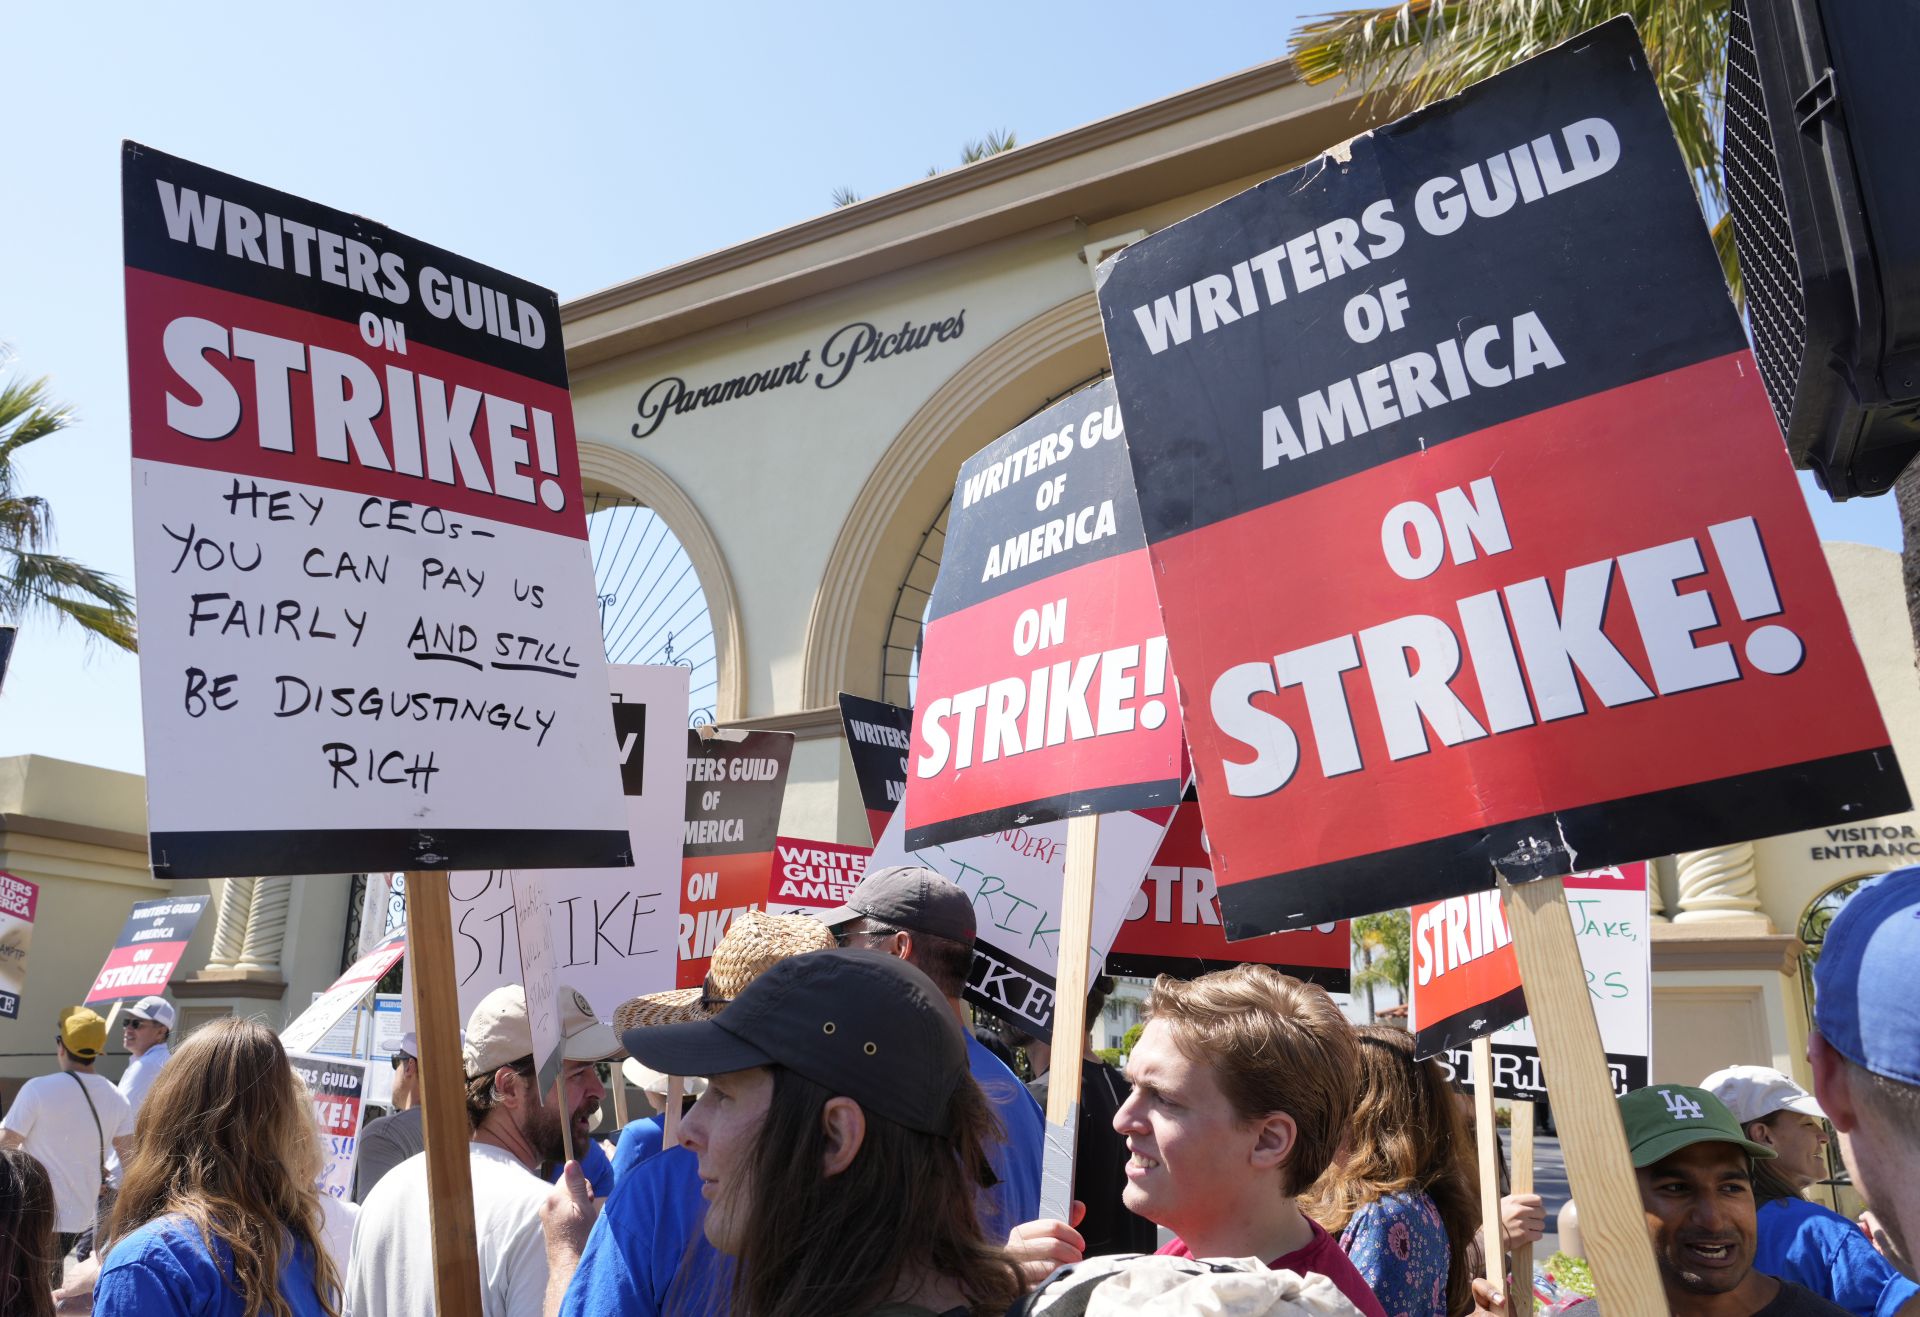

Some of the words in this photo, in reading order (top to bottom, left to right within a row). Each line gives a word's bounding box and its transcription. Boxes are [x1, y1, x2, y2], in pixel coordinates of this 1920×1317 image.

[1133, 198, 1405, 355] WRITERS
[1415, 117, 1621, 236] GUILD
[156, 179, 410, 305] WRITERS
[418, 266, 546, 350] GUILD
[358, 311, 408, 355] ON
[1343, 278, 1410, 344] OF
[631, 349, 810, 439] Paramount
[815, 308, 966, 390] Pictures
[1262, 310, 1567, 470] AMERICA
[162, 316, 566, 513] STRIKE!
[962, 433, 1073, 510] WRITERS
[1036, 474, 1067, 512] OF
[222, 479, 324, 526] HEY
[981, 499, 1117, 583] AMERICA
[1380, 475, 1513, 580] ON
[162, 523, 262, 574] YOU
[302, 547, 390, 586] CAN
[421, 557, 485, 595] PAY
[513, 578, 545, 608] US
[188, 593, 367, 647] FAIRLY
[407, 617, 478, 655] AND
[494, 632, 582, 670] STILL
[1013, 597, 1068, 657] ON
[1209, 516, 1806, 798] STRIKE!
[183, 666, 239, 718] BE
[273, 675, 556, 747] DISGUSTINGLY
[917, 635, 1169, 780] STRIKE!
[849, 719, 911, 751] WRITERS
[321, 742, 440, 794] RICH
[686, 758, 727, 782] TERS
[729, 758, 779, 782] GUILD
[702, 790, 721, 811] OF
[683, 818, 744, 845] MERICA
[1810, 842, 1920, 861] ENTRANC
[1825, 825, 1916, 842] VISITOR
[777, 845, 872, 872] WRITE
[782, 863, 865, 887] GUILD
[0, 876, 33, 898] ITERS
[687, 872, 719, 902] ON
[131, 927, 175, 942] AMERICA
[132, 905, 172, 920] WRITERS
[171, 903, 201, 915] GUILD
[132, 948, 154, 963] ON
[458, 891, 662, 987] STIKE
[1416, 888, 1513, 987] STRIK
[94, 961, 174, 991] STRIKE!
[321, 1071, 358, 1089] GUILD
[1658, 1089, 1705, 1120] LA
